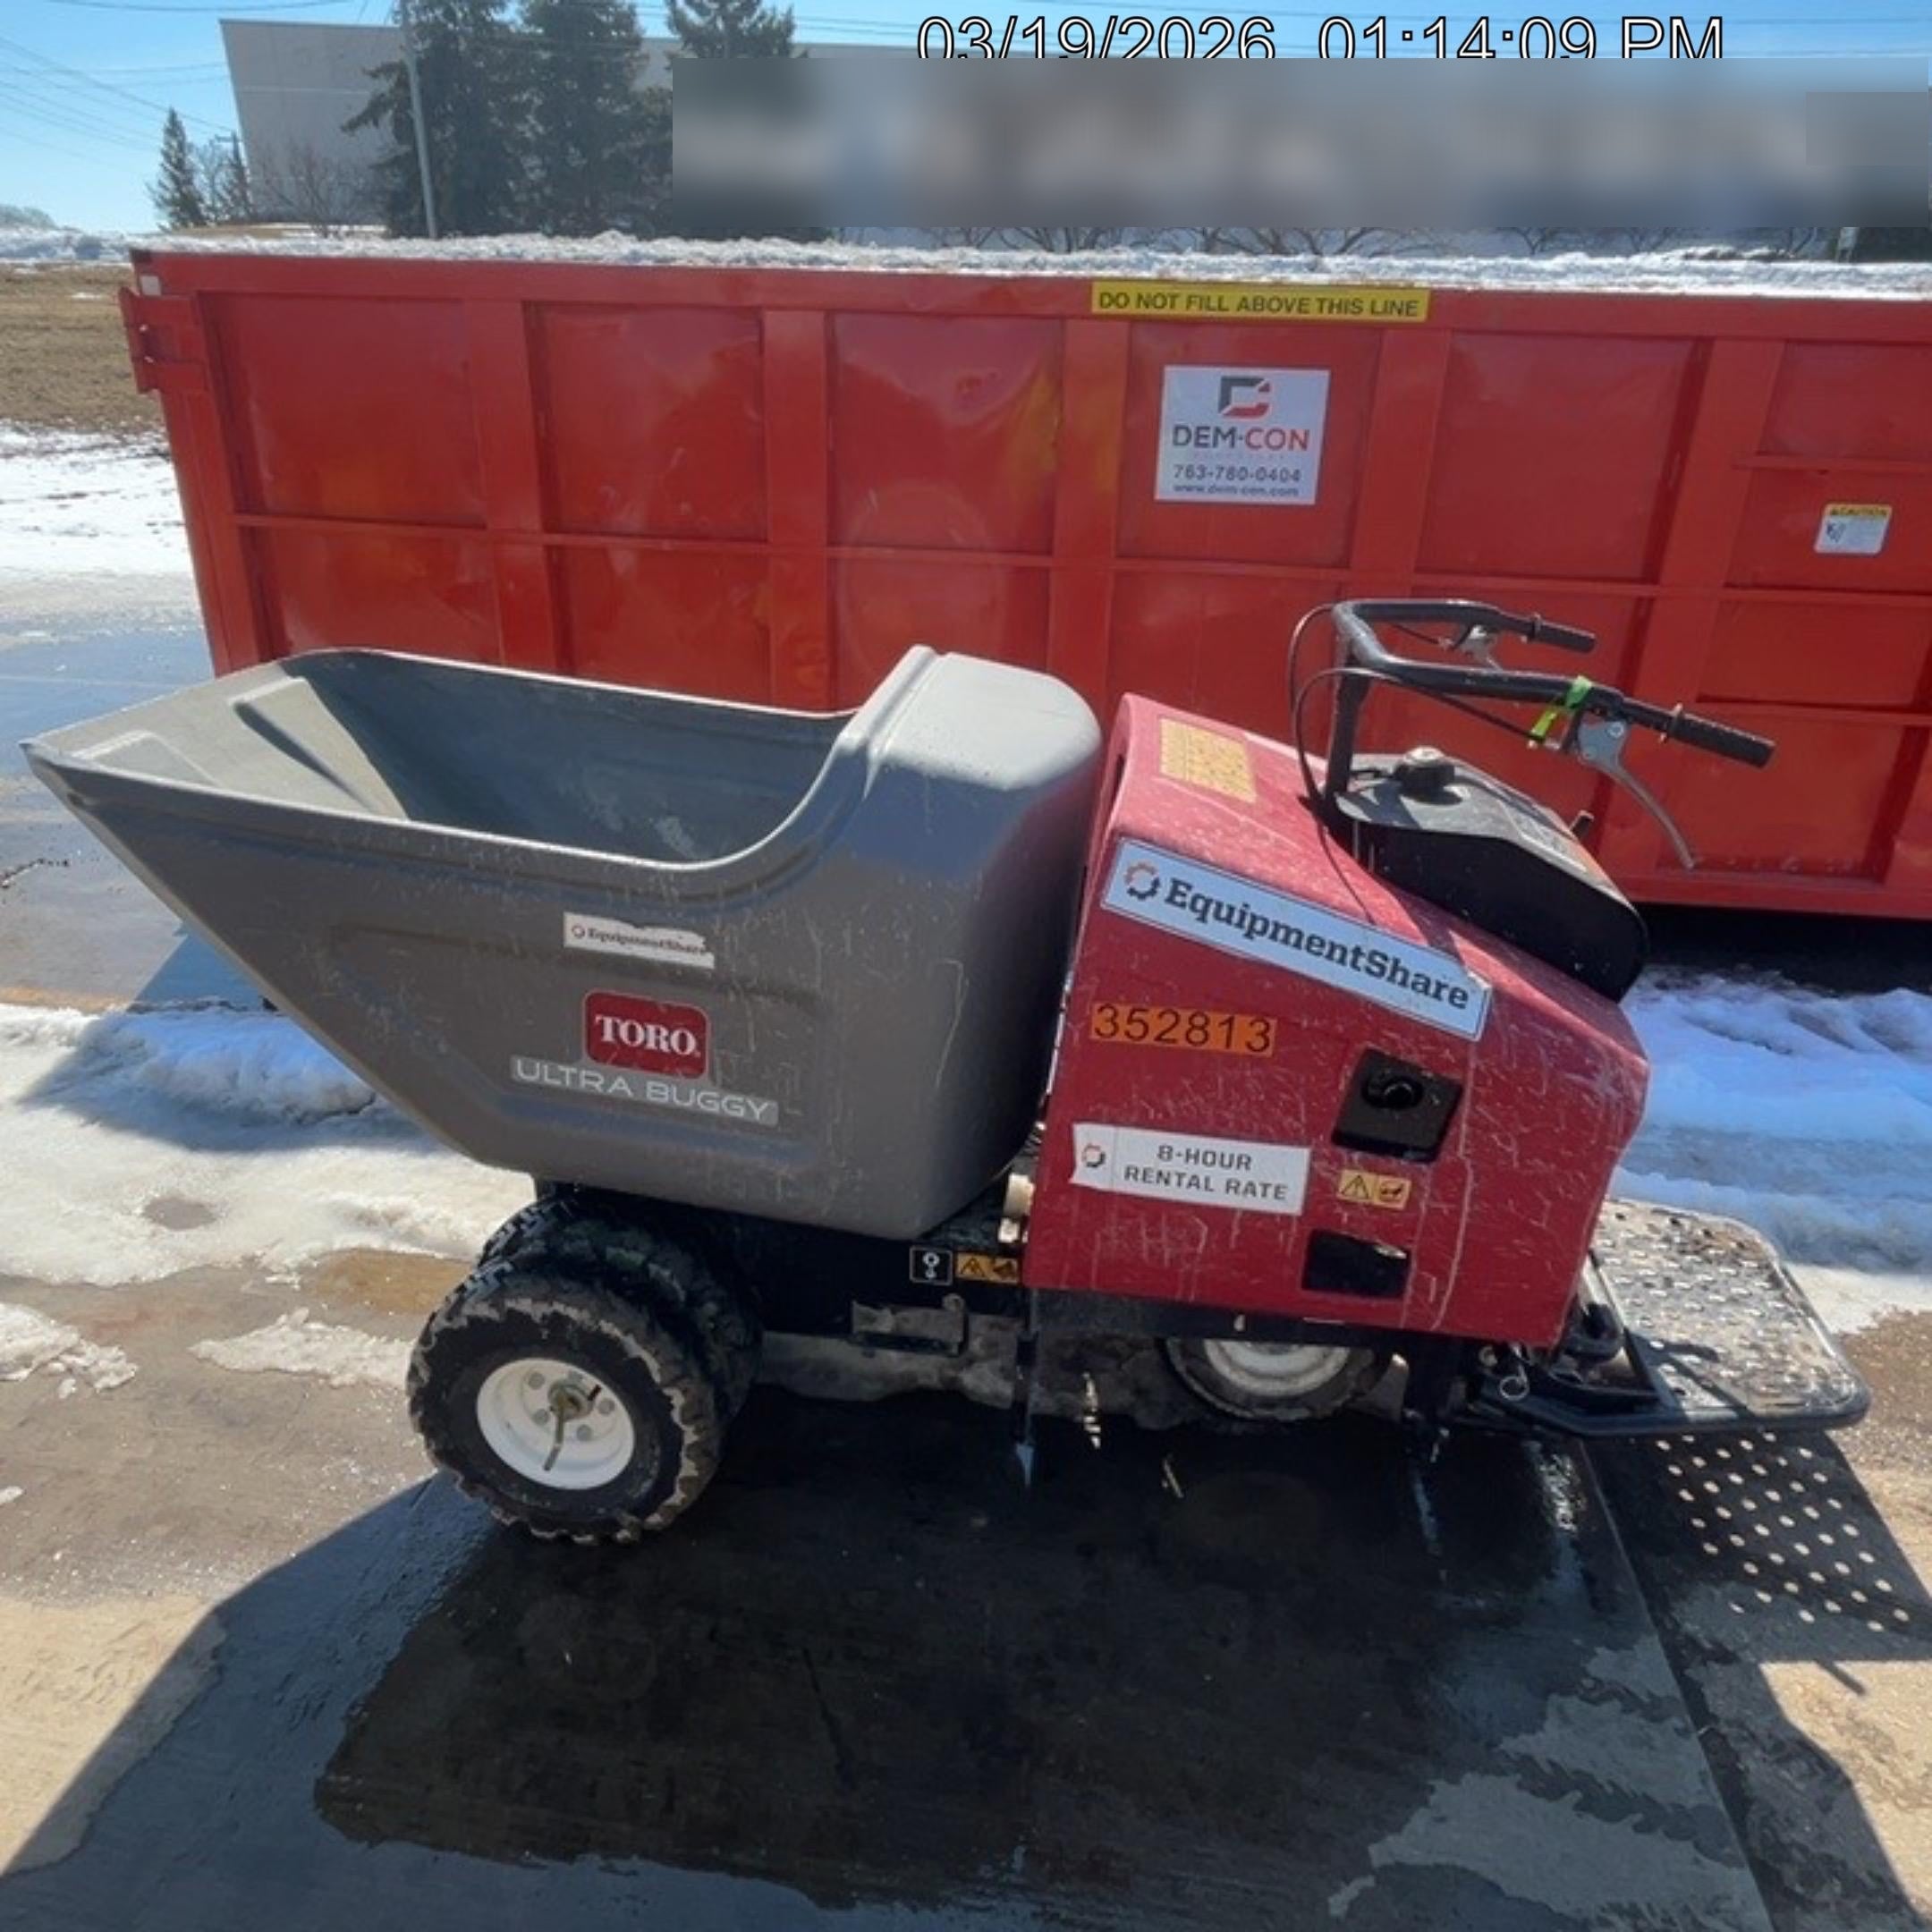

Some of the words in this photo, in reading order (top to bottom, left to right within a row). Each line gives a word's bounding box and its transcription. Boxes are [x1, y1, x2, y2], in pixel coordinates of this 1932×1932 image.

[1098, 292, 1130, 309] DO
[1137, 292, 1180, 311] NOT
[1186, 295, 1230, 312] FILL
[1236, 296, 1310, 314] ABOVE
[1317, 298, 1364, 316] THIS
[1369, 299, 1419, 318] LINE
[1172, 424, 1310, 452] DEM-CON
[1164, 876, 1470, 1010] EquipmentShare
[594, 1014, 697, 1056] TORO
[1093, 1002, 1271, 1054] 352813
[516, 1058, 634, 1097] ULTRA
[646, 1080, 769, 1122] BUGGY
[1157, 1144, 1252, 1172] 8-HOUR
[1123, 1166, 1215, 1194] RENTAL
[1225, 1179, 1289, 1201] RATE
